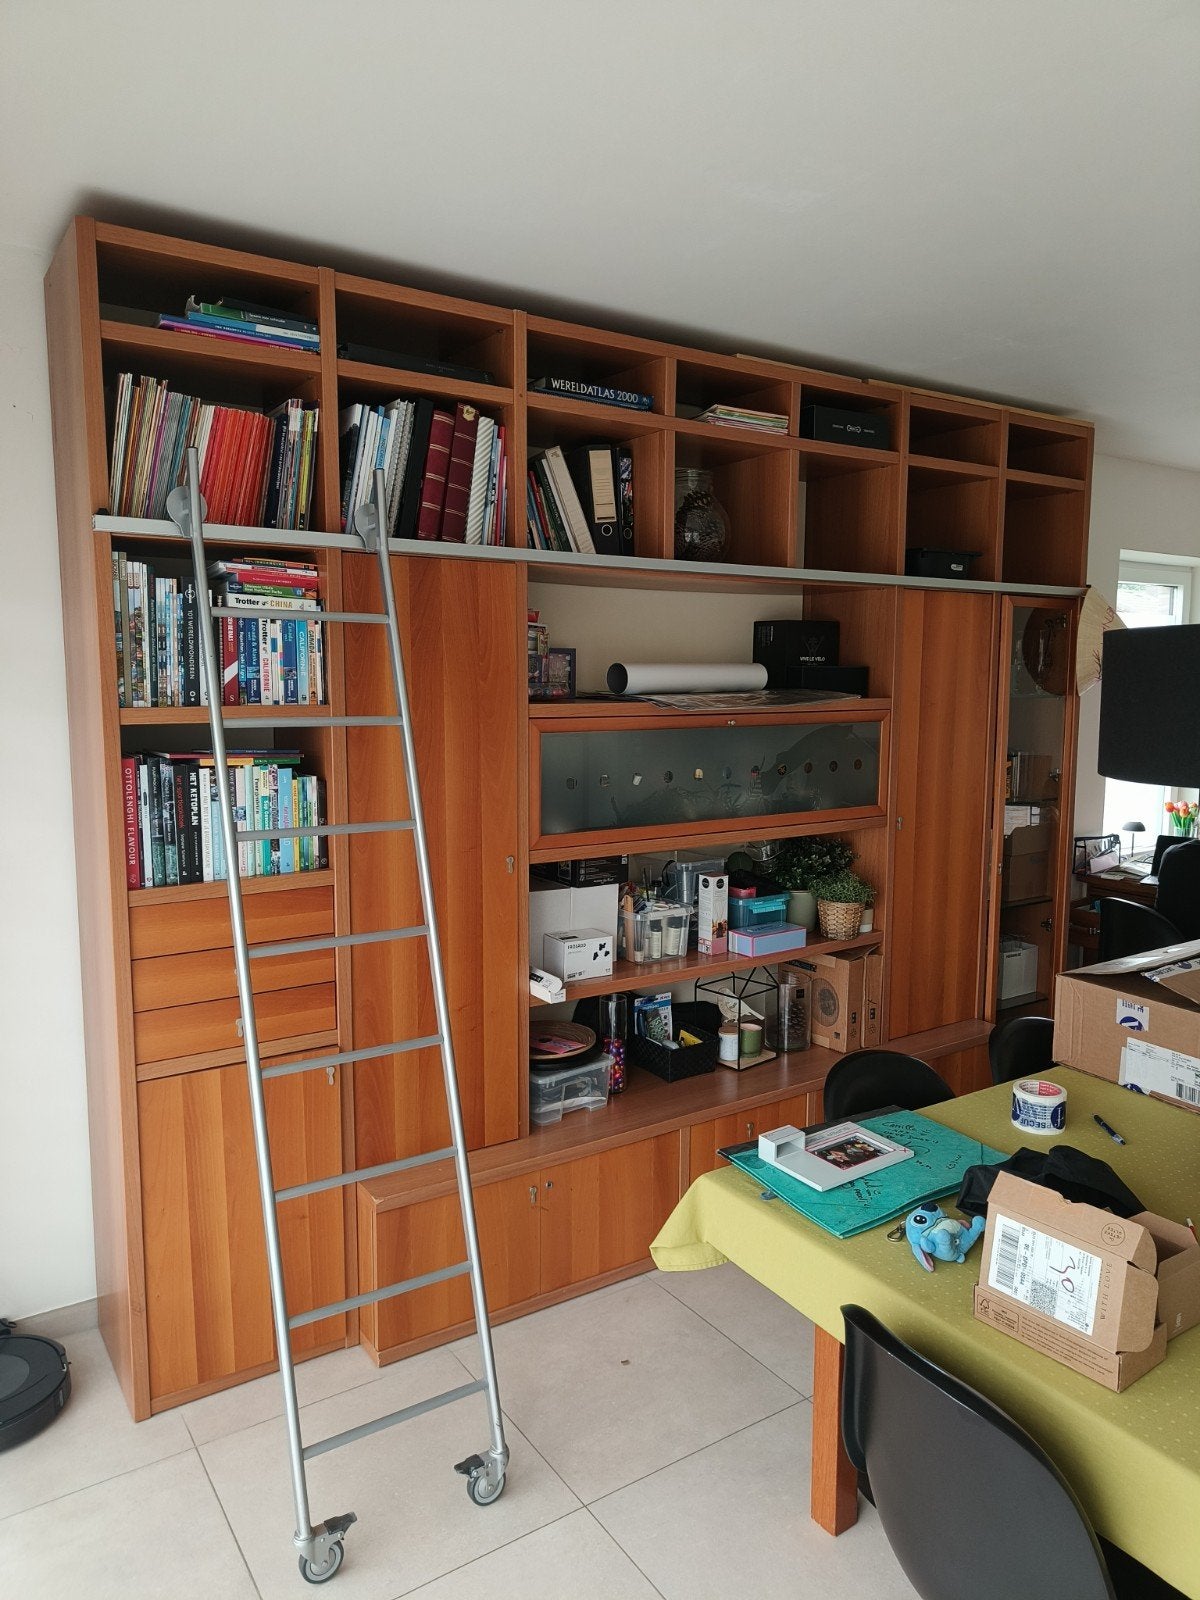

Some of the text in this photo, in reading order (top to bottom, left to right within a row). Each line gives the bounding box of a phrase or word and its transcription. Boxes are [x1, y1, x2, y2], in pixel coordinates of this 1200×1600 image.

[550, 378, 639, 403] WERELDATLAS 2000
[235, 597, 293, 609] Trotter CHINA
[187, 619, 195, 680] WERELDWONDEREN
[299, 631, 307, 676] CALIFORNIE
[262, 658, 270, 692] CALIFORNIE
[189, 772, 197, 786] HET
[124, 767, 136, 866] OTTOLENGHI FLAVOUR
[190, 788, 199, 826] KETOPLAN
[1099, 1262, 1113, 1321] WITH LOVE
